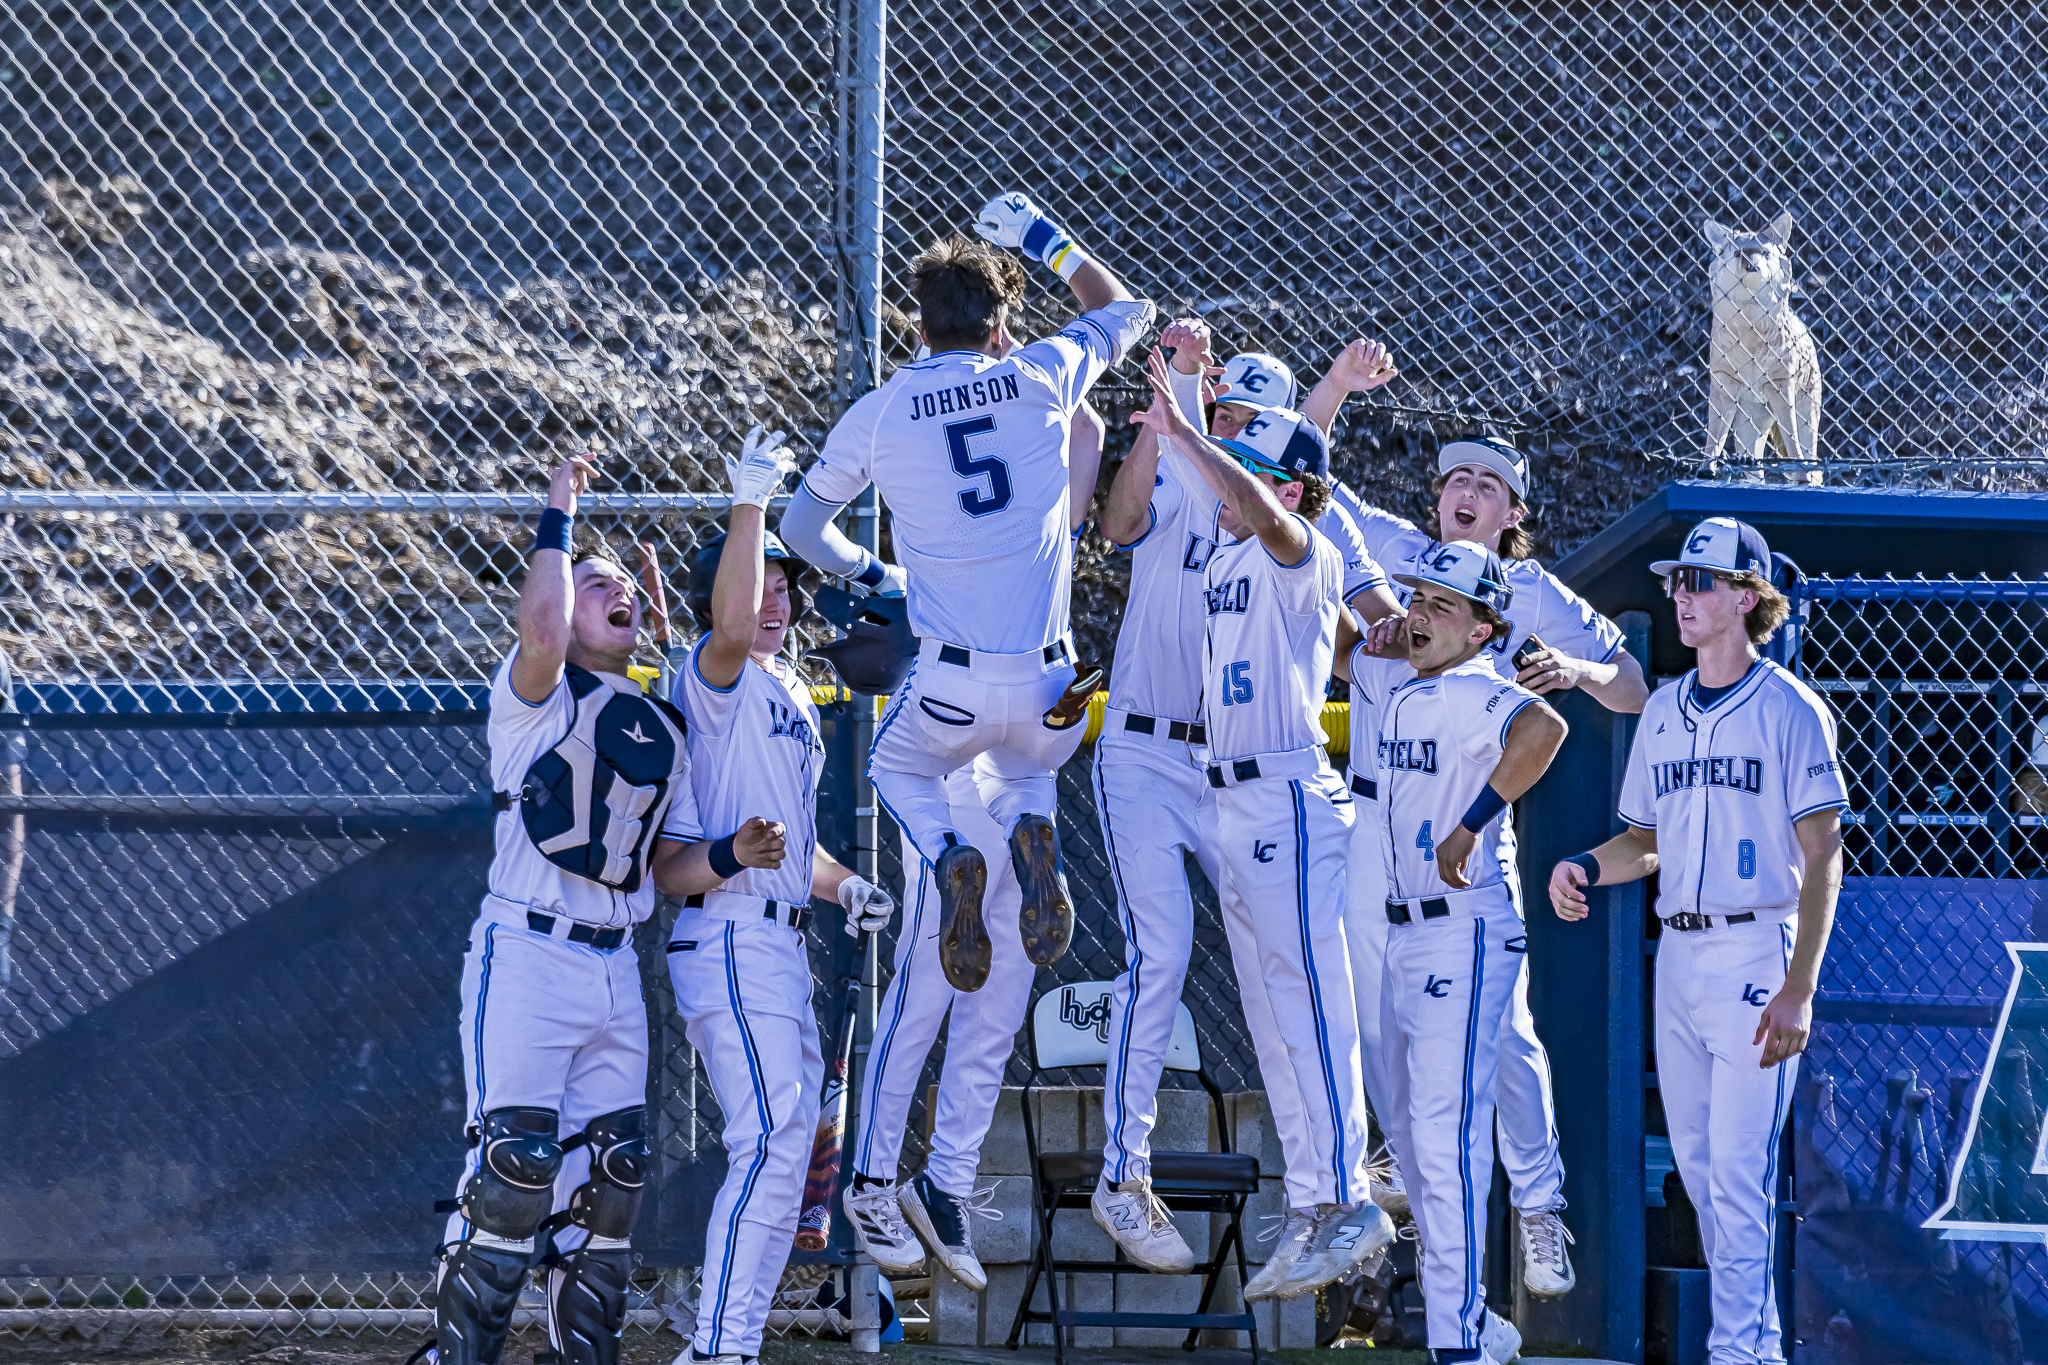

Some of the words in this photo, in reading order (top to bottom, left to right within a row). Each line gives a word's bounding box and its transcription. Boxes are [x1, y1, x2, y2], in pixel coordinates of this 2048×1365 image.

[1235, 365, 1271, 394] LC
[910, 374, 1020, 421] JOHNSON
[942, 413, 1015, 519] 5
[1685, 528, 1714, 555] LC
[1429, 547, 1462, 573] LC
[1222, 660, 1255, 707] 15
[1650, 755, 1765, 801] LINFIELD
[1806, 762, 1827, 779] FOR
[1252, 839, 1278, 864] LC
[1416, 819, 1434, 862] 4
[1737, 839, 1757, 880] 8
[1423, 974, 1454, 999] LC
[1741, 983, 1770, 1007] LC
